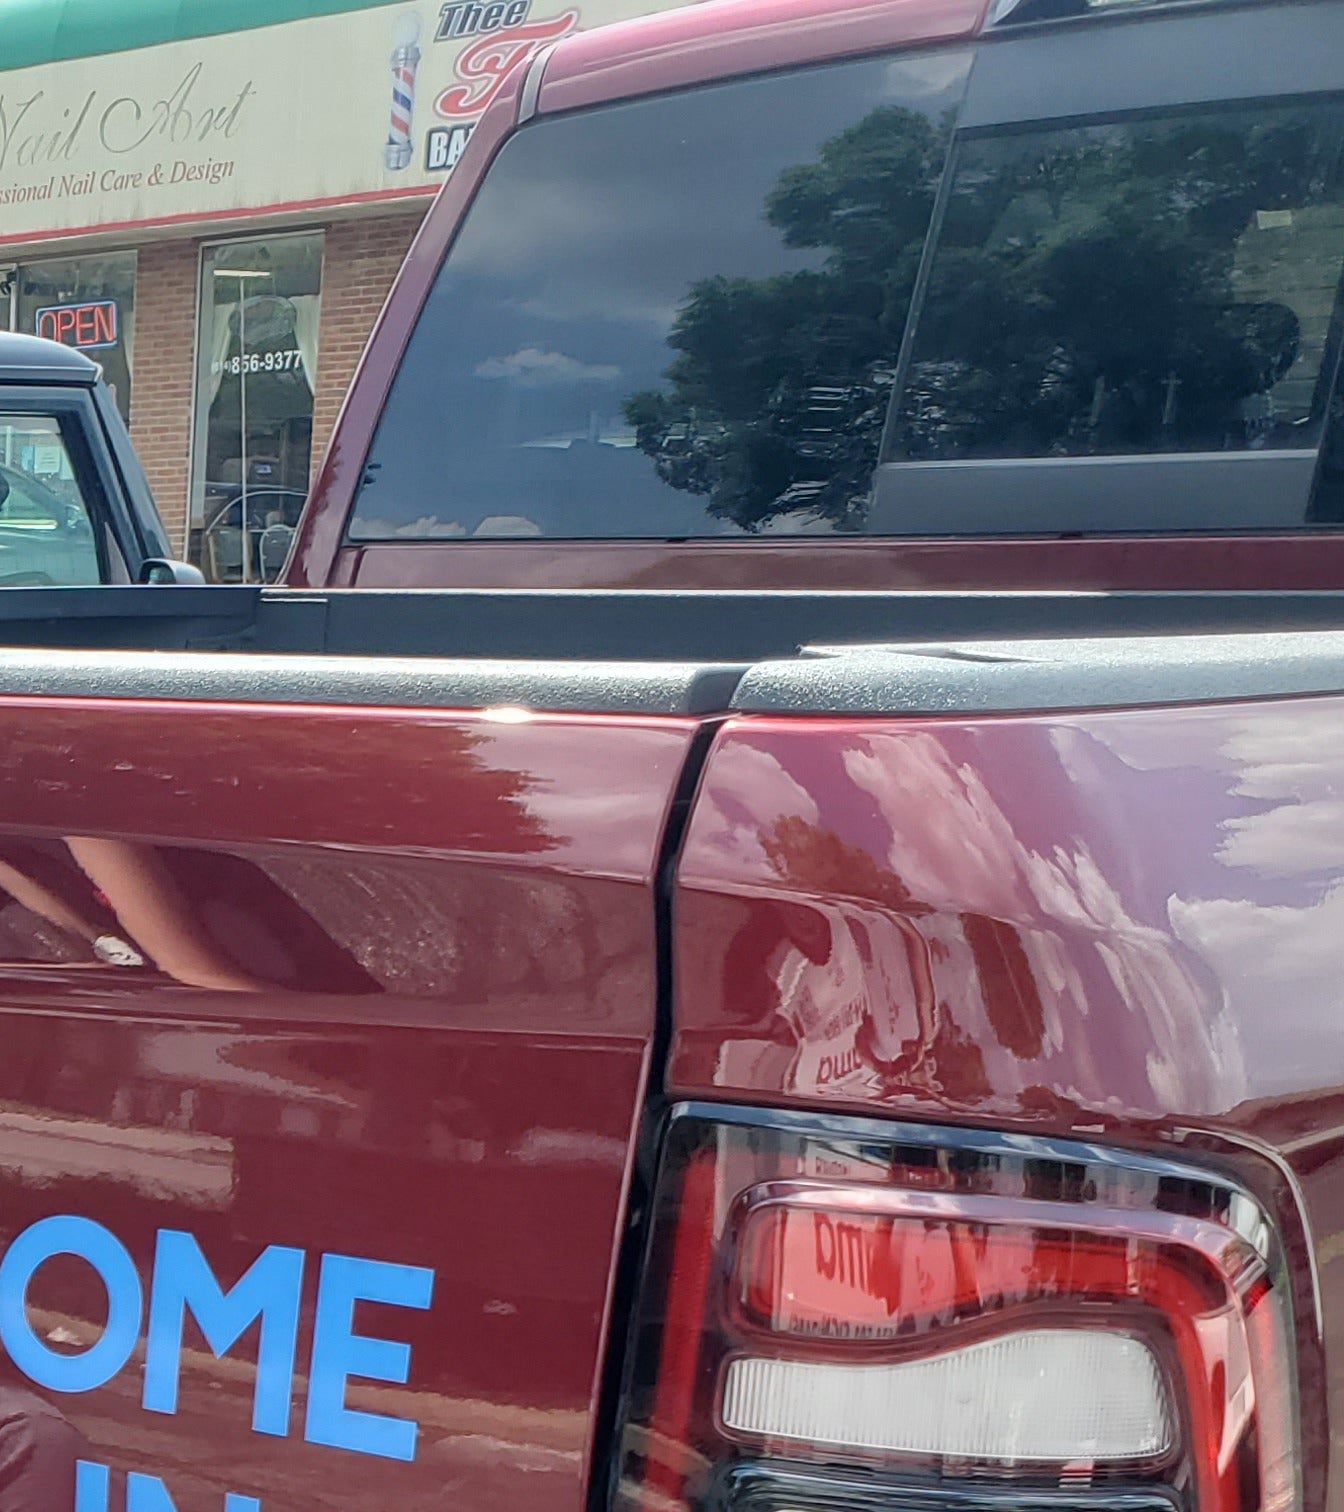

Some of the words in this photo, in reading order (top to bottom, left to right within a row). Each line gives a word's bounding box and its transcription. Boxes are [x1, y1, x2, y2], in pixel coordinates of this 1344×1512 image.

[436, 0, 528, 40] Thee
[99, 62, 258, 154] Art
[57, 170, 97, 199] Nail
[100, 169, 143, 193] Care
[147, 162, 165, 186] &
[169, 157, 235, 184] Design
[39, 302, 116, 346] OPEN
